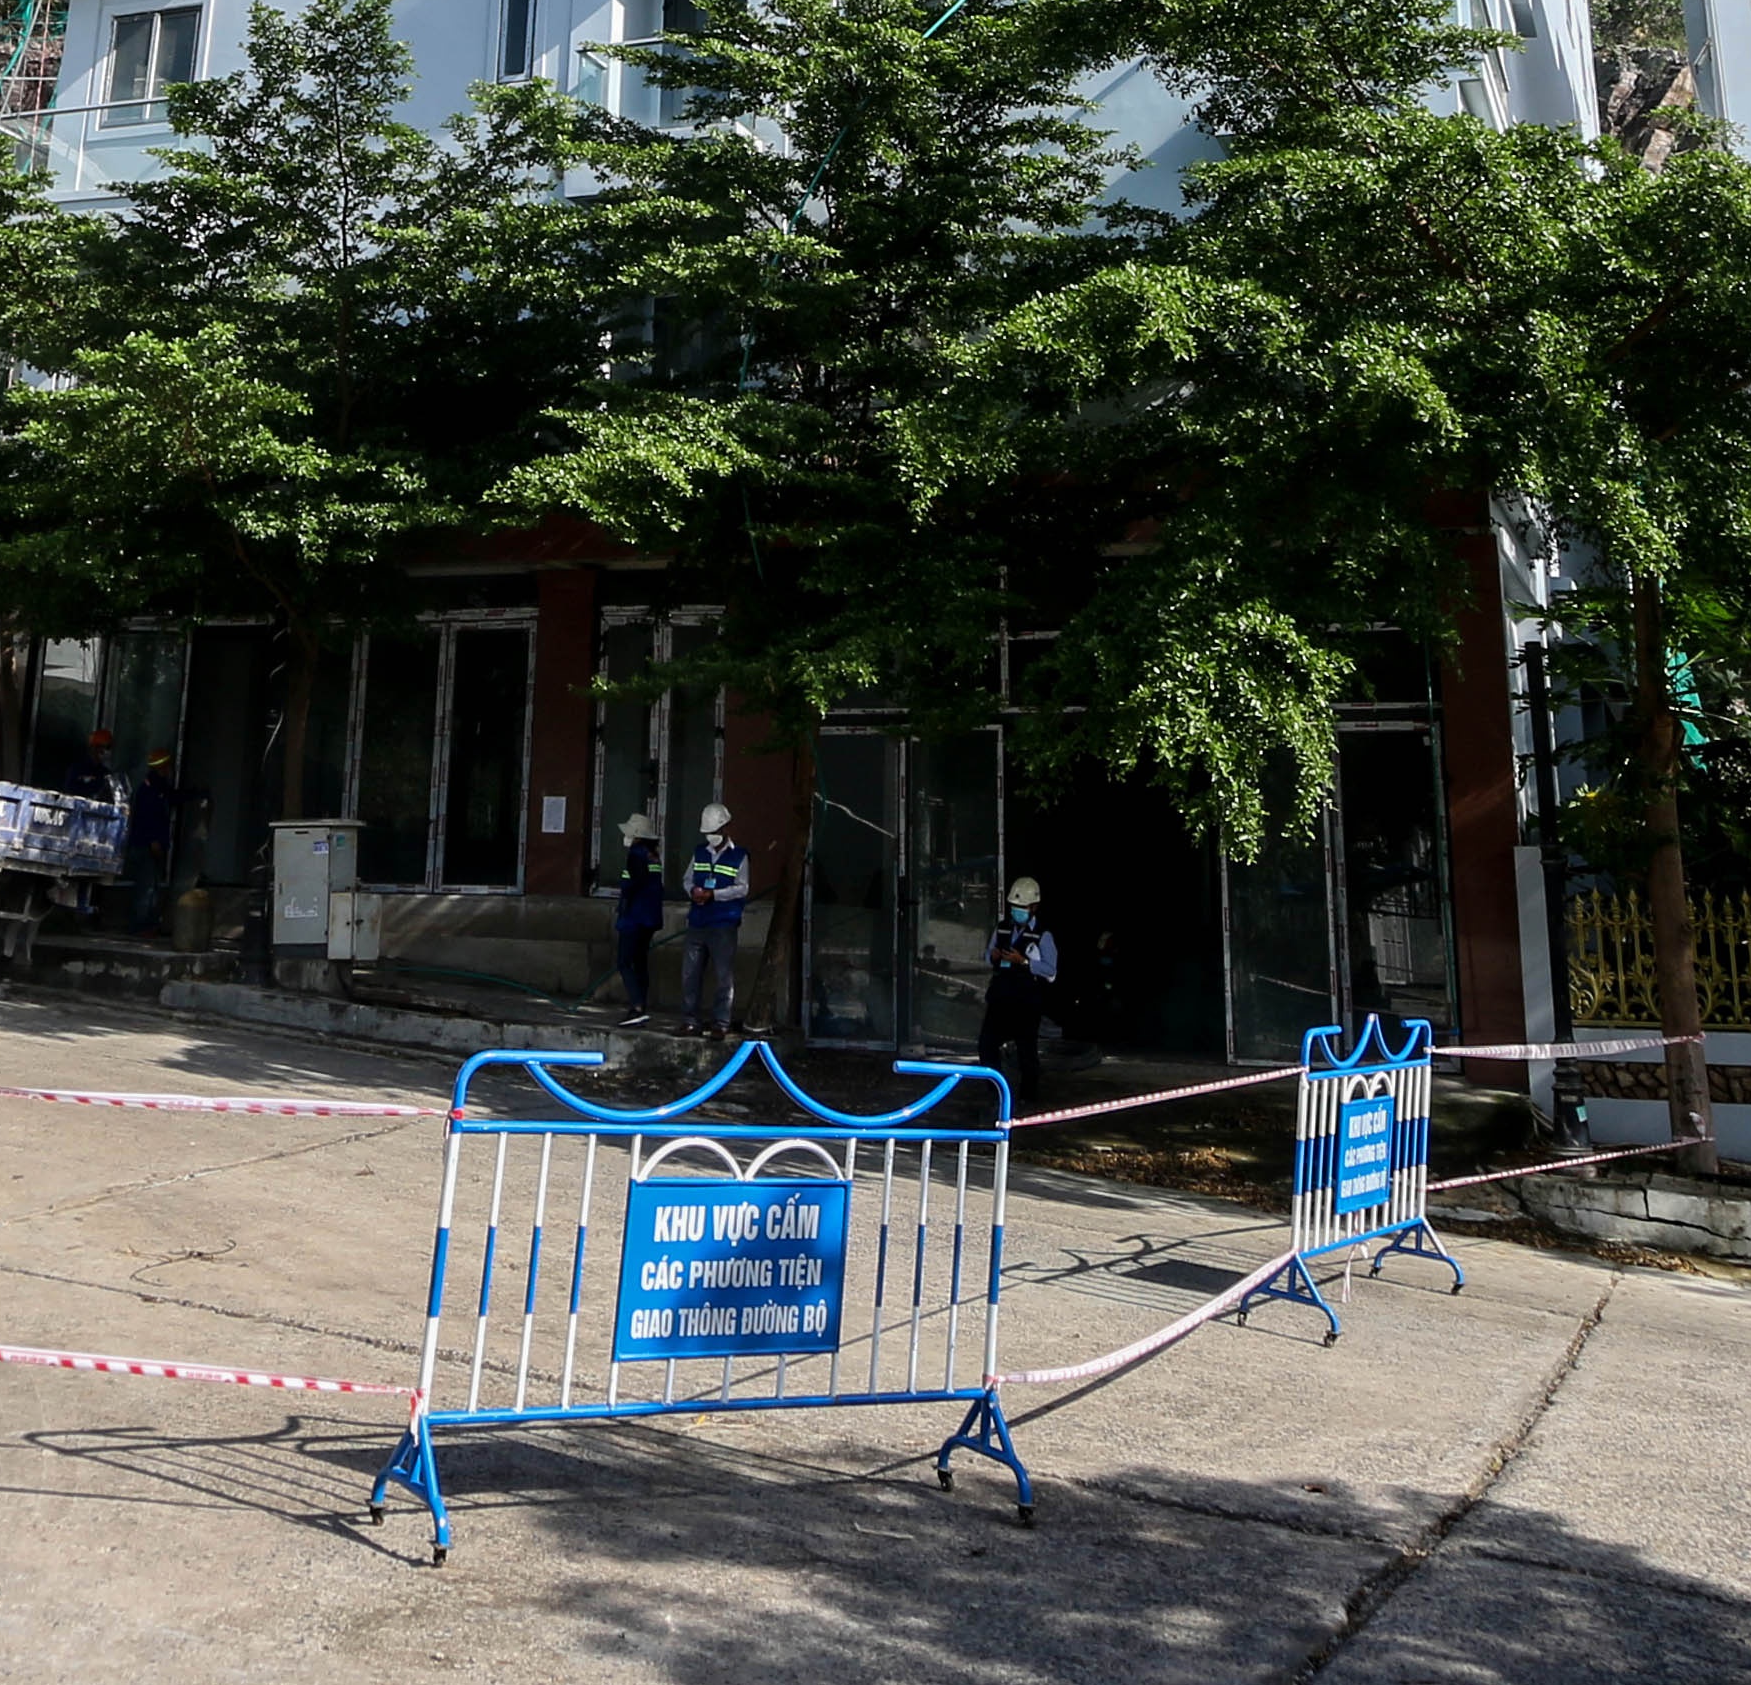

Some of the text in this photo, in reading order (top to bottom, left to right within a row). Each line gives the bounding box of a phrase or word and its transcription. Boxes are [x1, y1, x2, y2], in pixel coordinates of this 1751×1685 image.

[654, 1192, 820, 1247] KHU VỰC CẤM
[641, 1253, 823, 1290] CÁC PHƯƠNG TIỆN
[630, 1298, 828, 1339] GIAO THÔNG ĐƯỜNG BỘ
